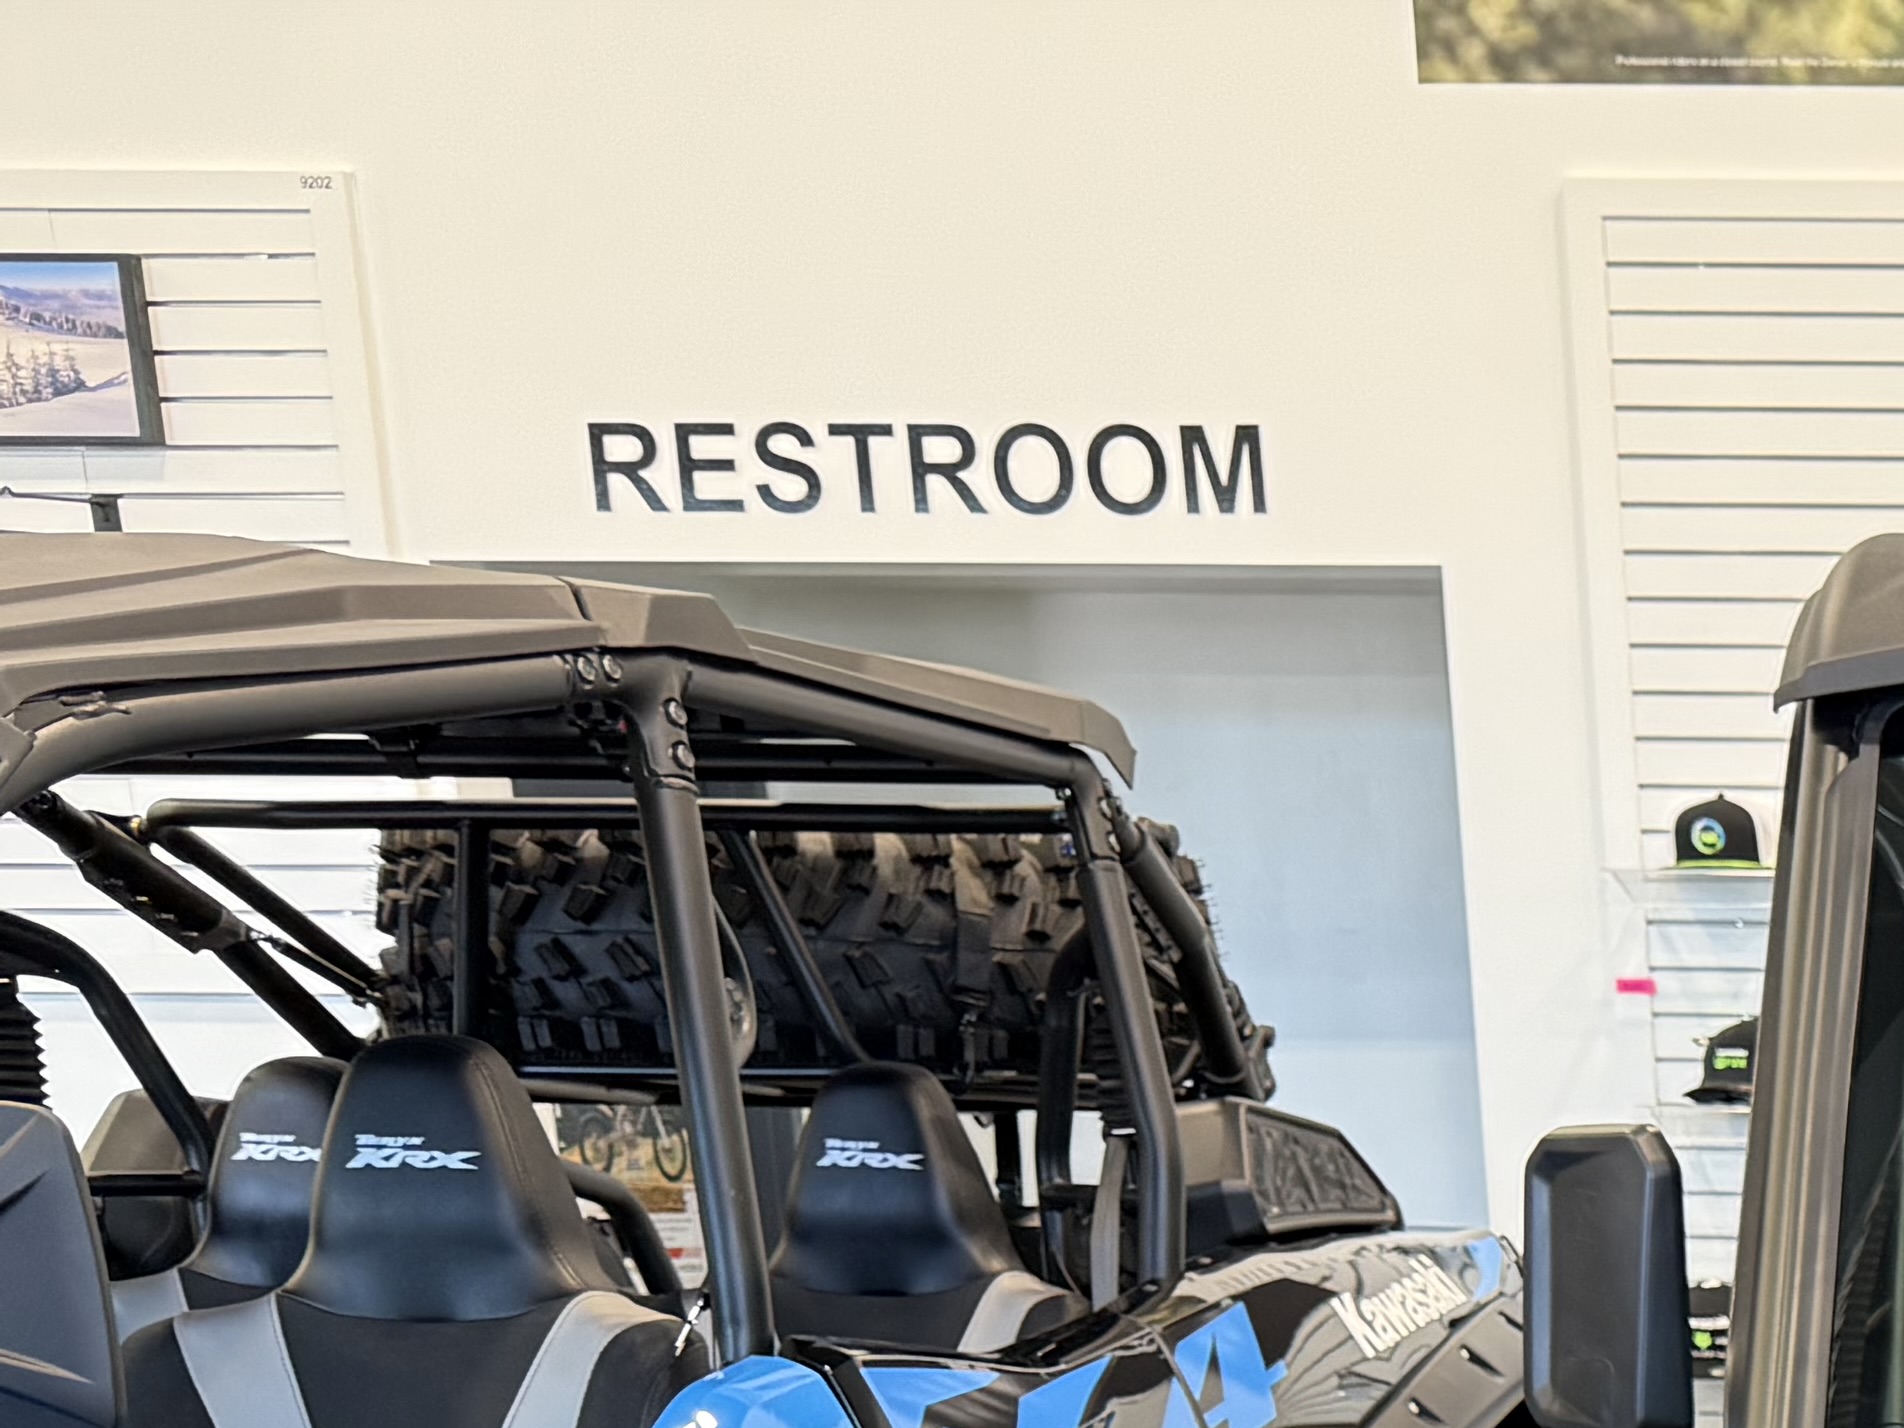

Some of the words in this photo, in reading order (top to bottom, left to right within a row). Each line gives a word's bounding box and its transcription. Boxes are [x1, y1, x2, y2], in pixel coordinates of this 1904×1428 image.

[299, 175, 333, 190] 9202
[587, 422, 1267, 515] RESTROOM
[345, 1147, 482, 1171] KRX
[1328, 1253, 1468, 1359] Kawasaki
